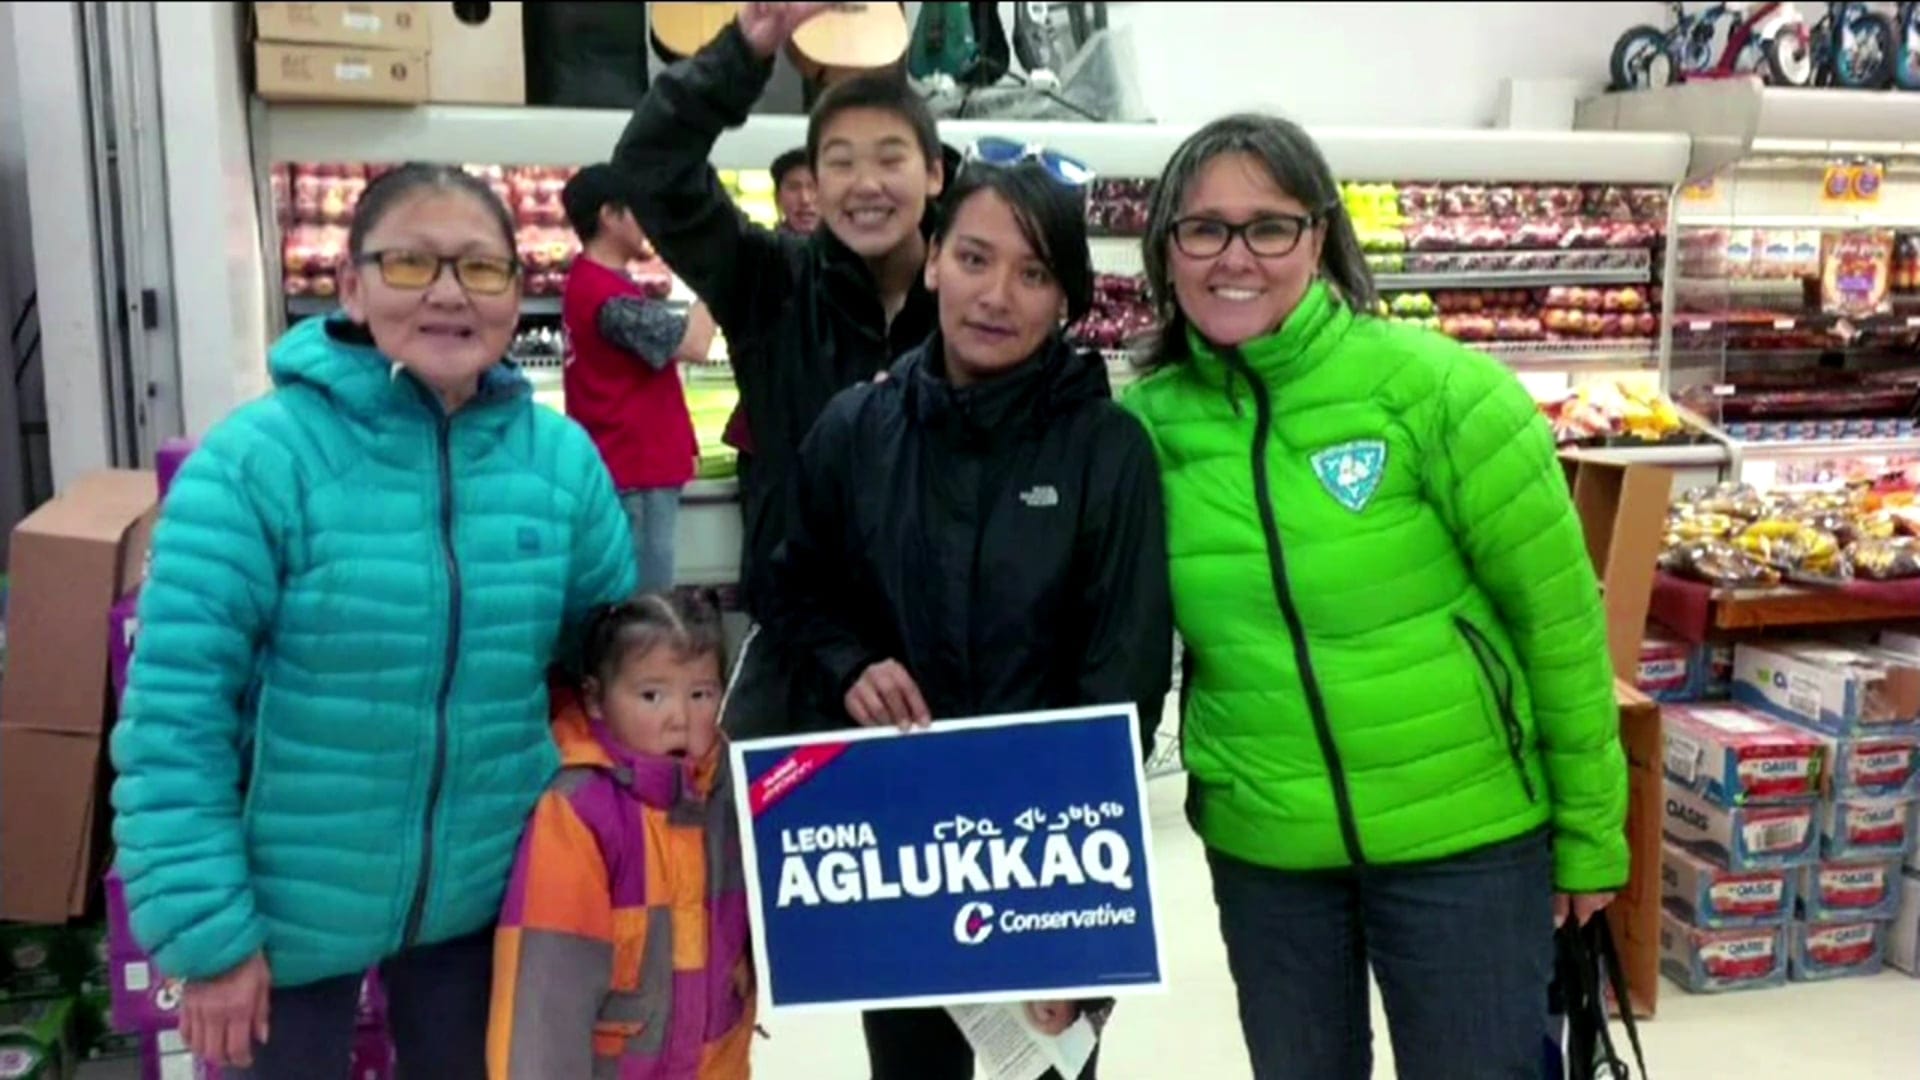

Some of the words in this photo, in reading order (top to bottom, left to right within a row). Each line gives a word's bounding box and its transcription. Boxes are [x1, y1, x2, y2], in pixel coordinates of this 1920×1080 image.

[1666, 799, 1709, 832] OASIS
[781, 822, 877, 853] LEONA
[776, 829, 1133, 908] AGLUKKAQ
[1000, 903, 1136, 933] Conservative
